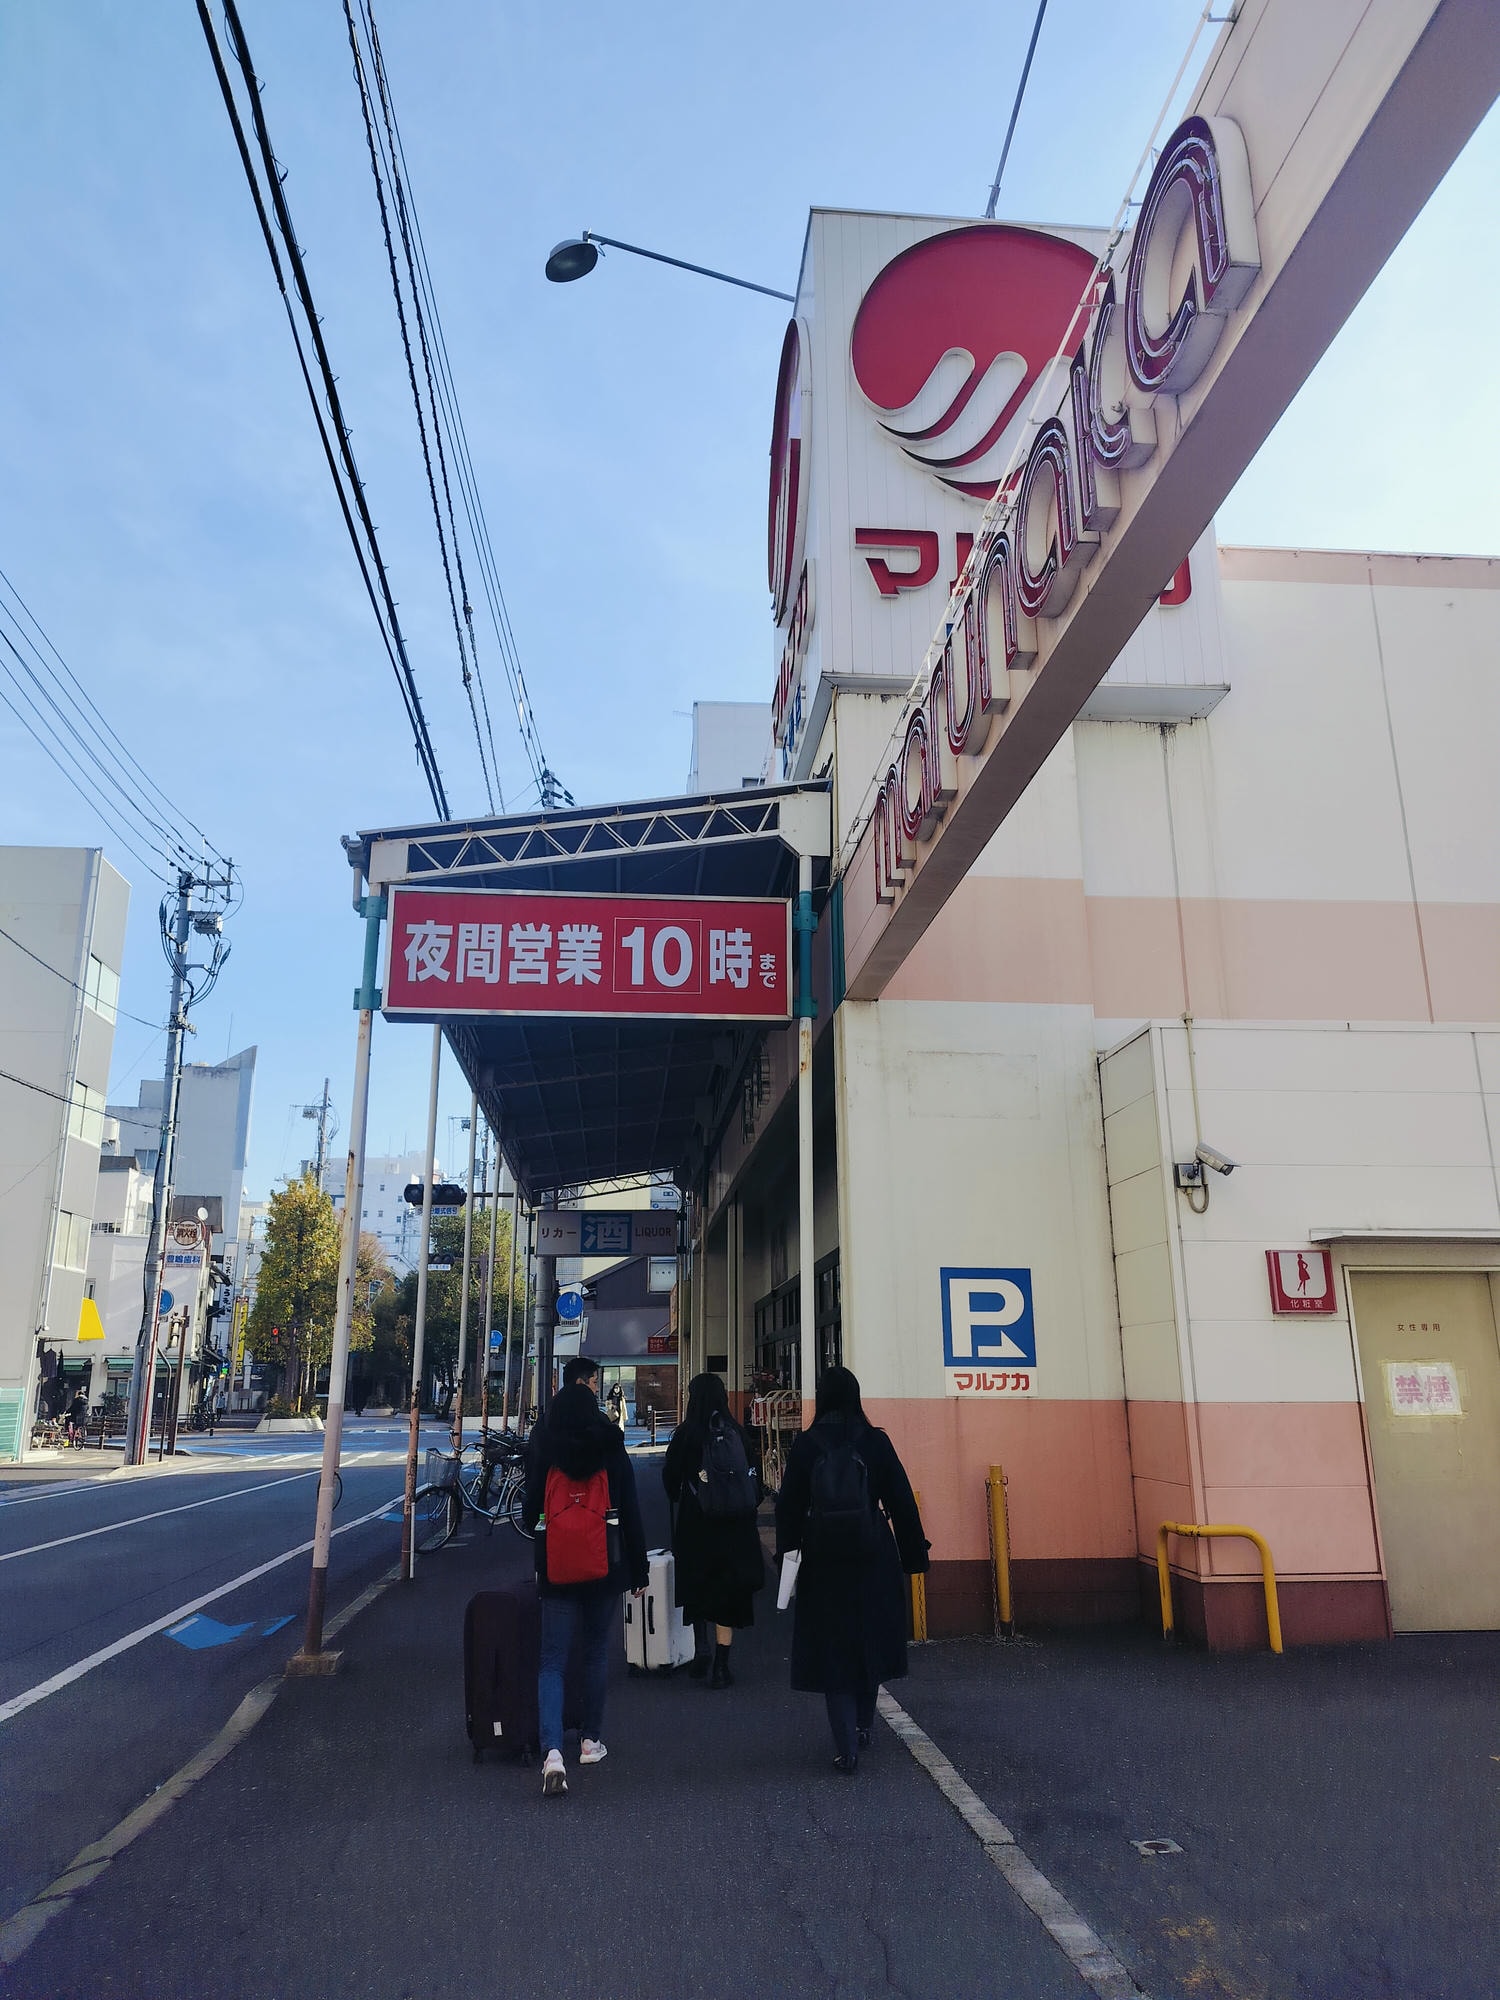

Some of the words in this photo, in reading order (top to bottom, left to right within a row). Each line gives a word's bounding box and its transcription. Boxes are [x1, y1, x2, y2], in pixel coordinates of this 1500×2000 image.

[874, 114, 1262, 902] marunaka
[403, 919, 604, 986] 夜間営業
[541, 1227, 577, 1239] リカー
[583, 1215, 630, 1250] 酒
[635, 1227, 672, 1238] LIQUOR
[949, 1278, 1025, 1358] P
[1290, 1299, 1323, 1309] 化粧室
[1396, 1323, 1441, 1332] 女性専用
[953, 1372, 1030, 1391] マルナカ
[1394, 1374, 1453, 1404] 禁煙
